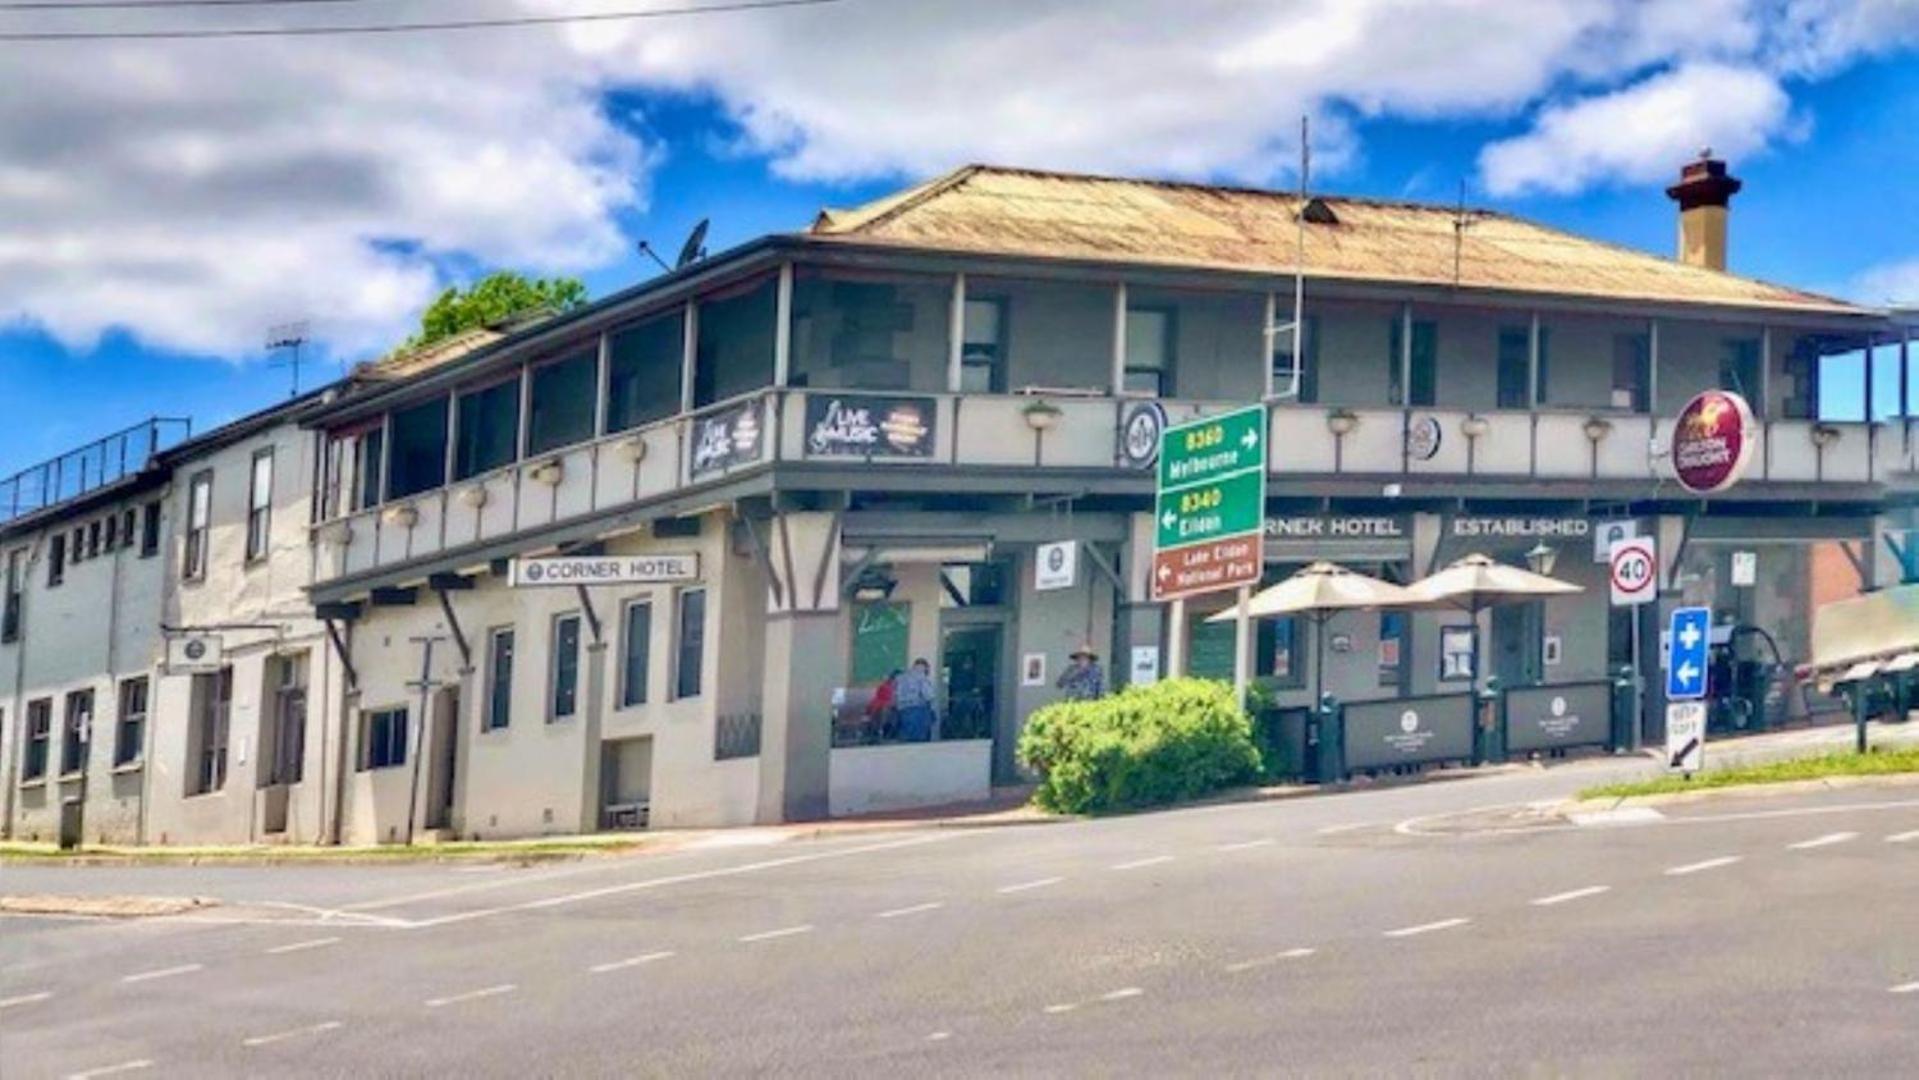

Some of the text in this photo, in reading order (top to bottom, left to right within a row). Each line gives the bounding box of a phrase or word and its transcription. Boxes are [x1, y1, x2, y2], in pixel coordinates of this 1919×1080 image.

[838, 408, 869, 426] LIVE
[822, 426, 879, 443] MUSIC
[1170, 451, 1238, 479] Melbourne
[1264, 518, 1401, 535] RNER HOTEL
[1453, 518, 1589, 536] ESTABLISHED
[547, 560, 686, 578] CORNER HOTEL
[1620, 559, 1646, 580] 40
